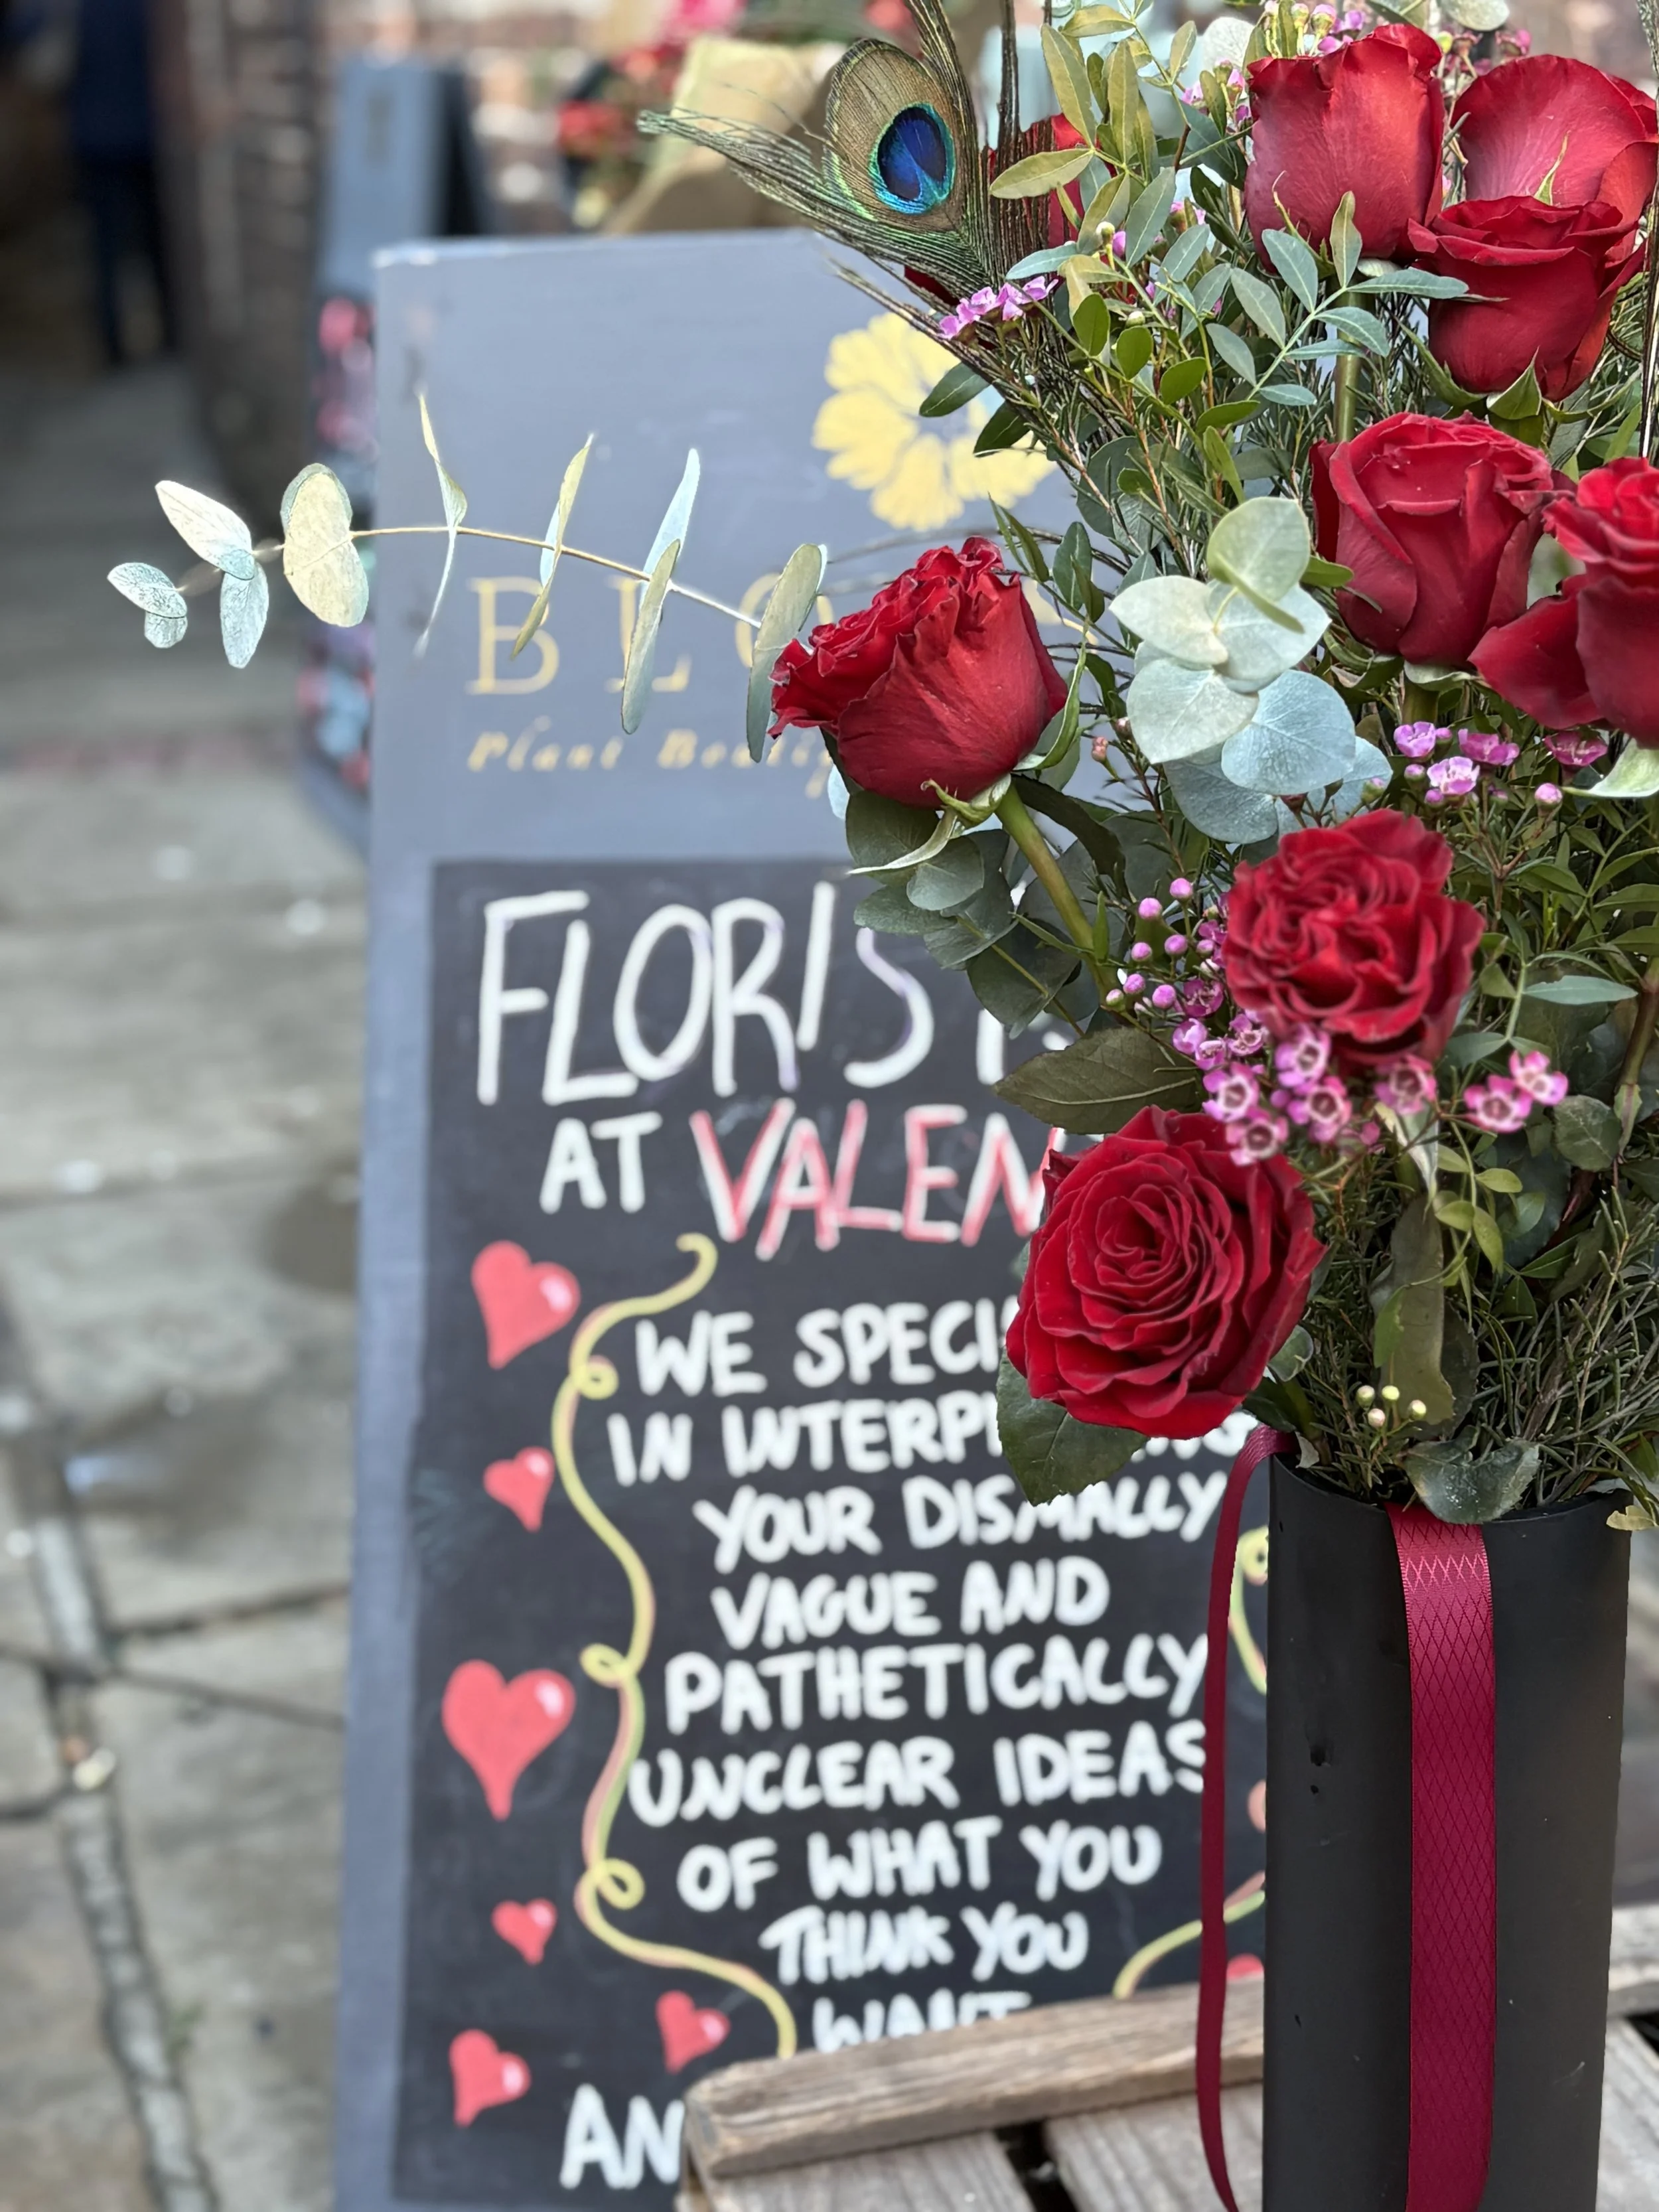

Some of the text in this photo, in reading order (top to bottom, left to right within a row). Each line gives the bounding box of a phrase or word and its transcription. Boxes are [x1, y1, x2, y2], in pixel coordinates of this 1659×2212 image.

[657, 729, 832, 799] Boutiq
[477, 881, 1007, 1106] FLORIS
[540, 1098, 1067, 1260] AT VALEN
[636, 1297, 1019, 1398] WE SPECI
[607, 1412, 692, 1486] IN
[692, 1471, 1228, 1574] YOUR DISMALLY
[711, 1555, 1110, 1651] VAGUE AND
[666, 1633, 1208, 1735] PATHETICALLY
[627, 1720, 1205, 1826] UNCLEAR IDEAS
[676, 1816, 1162, 1912] OF WHAT YOU
[758, 1901, 1089, 1985] THINK YOU
